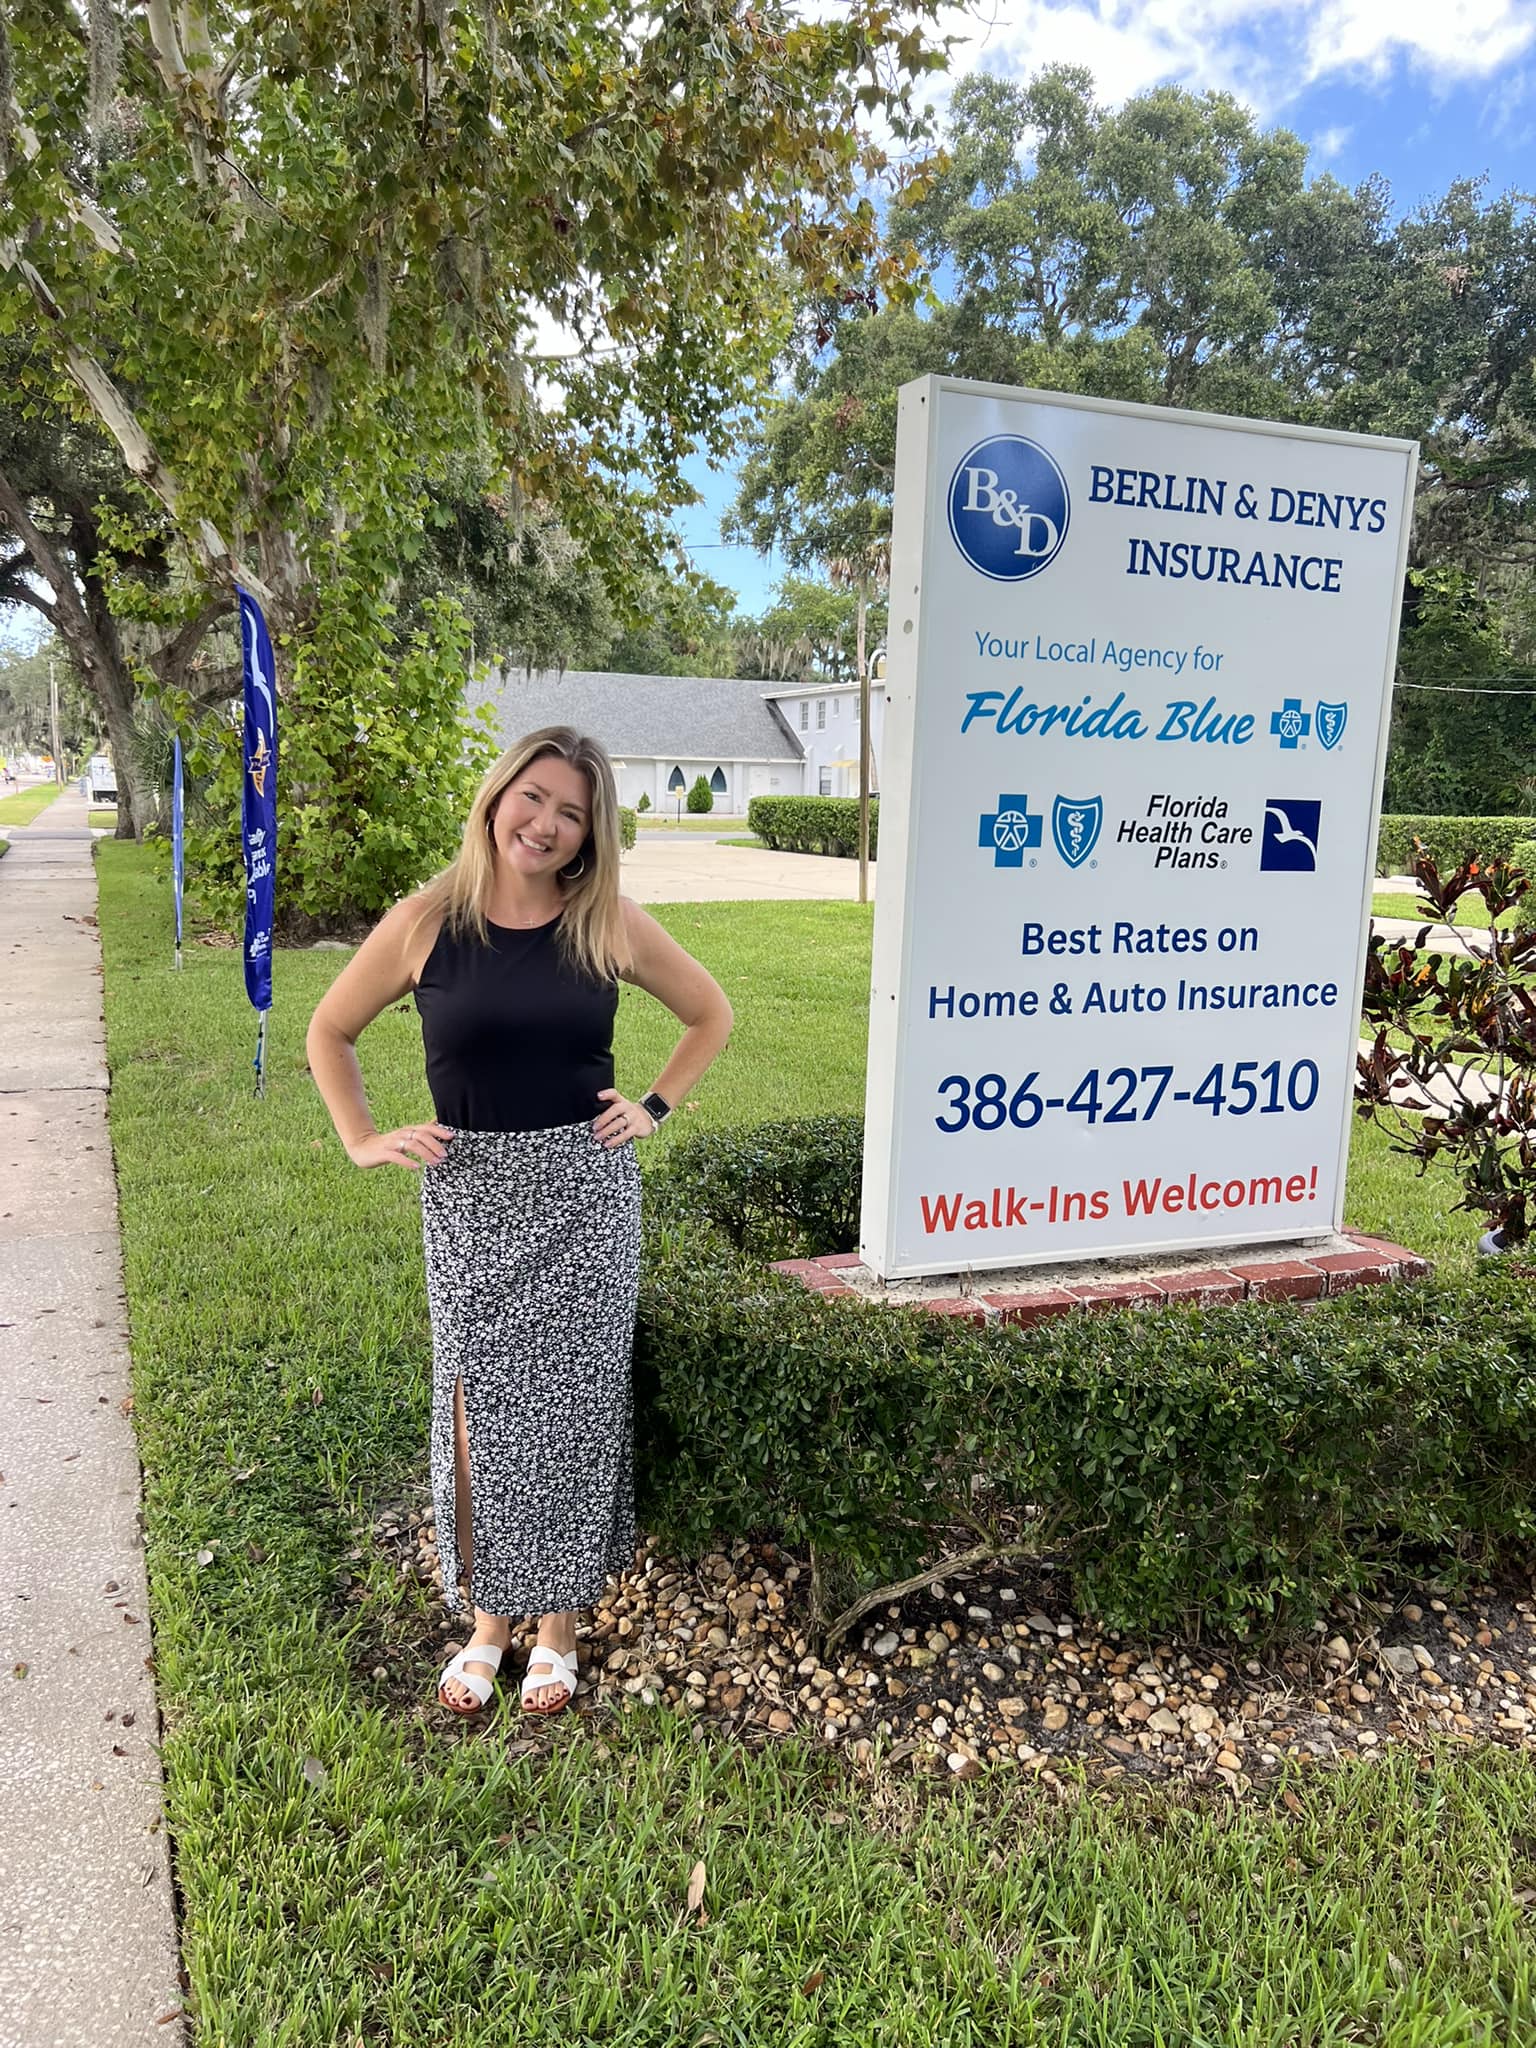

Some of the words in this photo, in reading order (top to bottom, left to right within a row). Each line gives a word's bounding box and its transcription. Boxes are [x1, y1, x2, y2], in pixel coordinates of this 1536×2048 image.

[962, 466, 1060, 557] B&D
[1089, 465, 1227, 517] BERLIN
[1234, 484, 1258, 520] &
[1268, 488, 1387, 533] DENYS
[1126, 538, 1343, 593] INSURANCE
[975, 631, 1030, 659] Your
[1036, 636, 1096, 664] Local
[1102, 640, 1188, 675] Agency
[1193, 645, 1224, 671] for
[960, 686, 1149, 740] Florida
[1155, 696, 1256, 745] Blue
[1117, 820, 1193, 845] Health
[1200, 821, 1253, 844] Care
[1147, 795, 1228, 818] Florida
[1021, 922, 1102, 956] Best
[1112, 921, 1208, 954] Rates
[1217, 927, 1258, 952] on
[928, 985, 1039, 1019] Home
[1048, 982, 1073, 1016] &
[1082, 982, 1167, 1014] Auto
[1177, 979, 1338, 1011] Insurance
[935, 1058, 1320, 1134] 386-427-4510
[920, 1186, 1109, 1234] Walk-Ins
[1122, 1165, 1318, 1217] Welcome!
